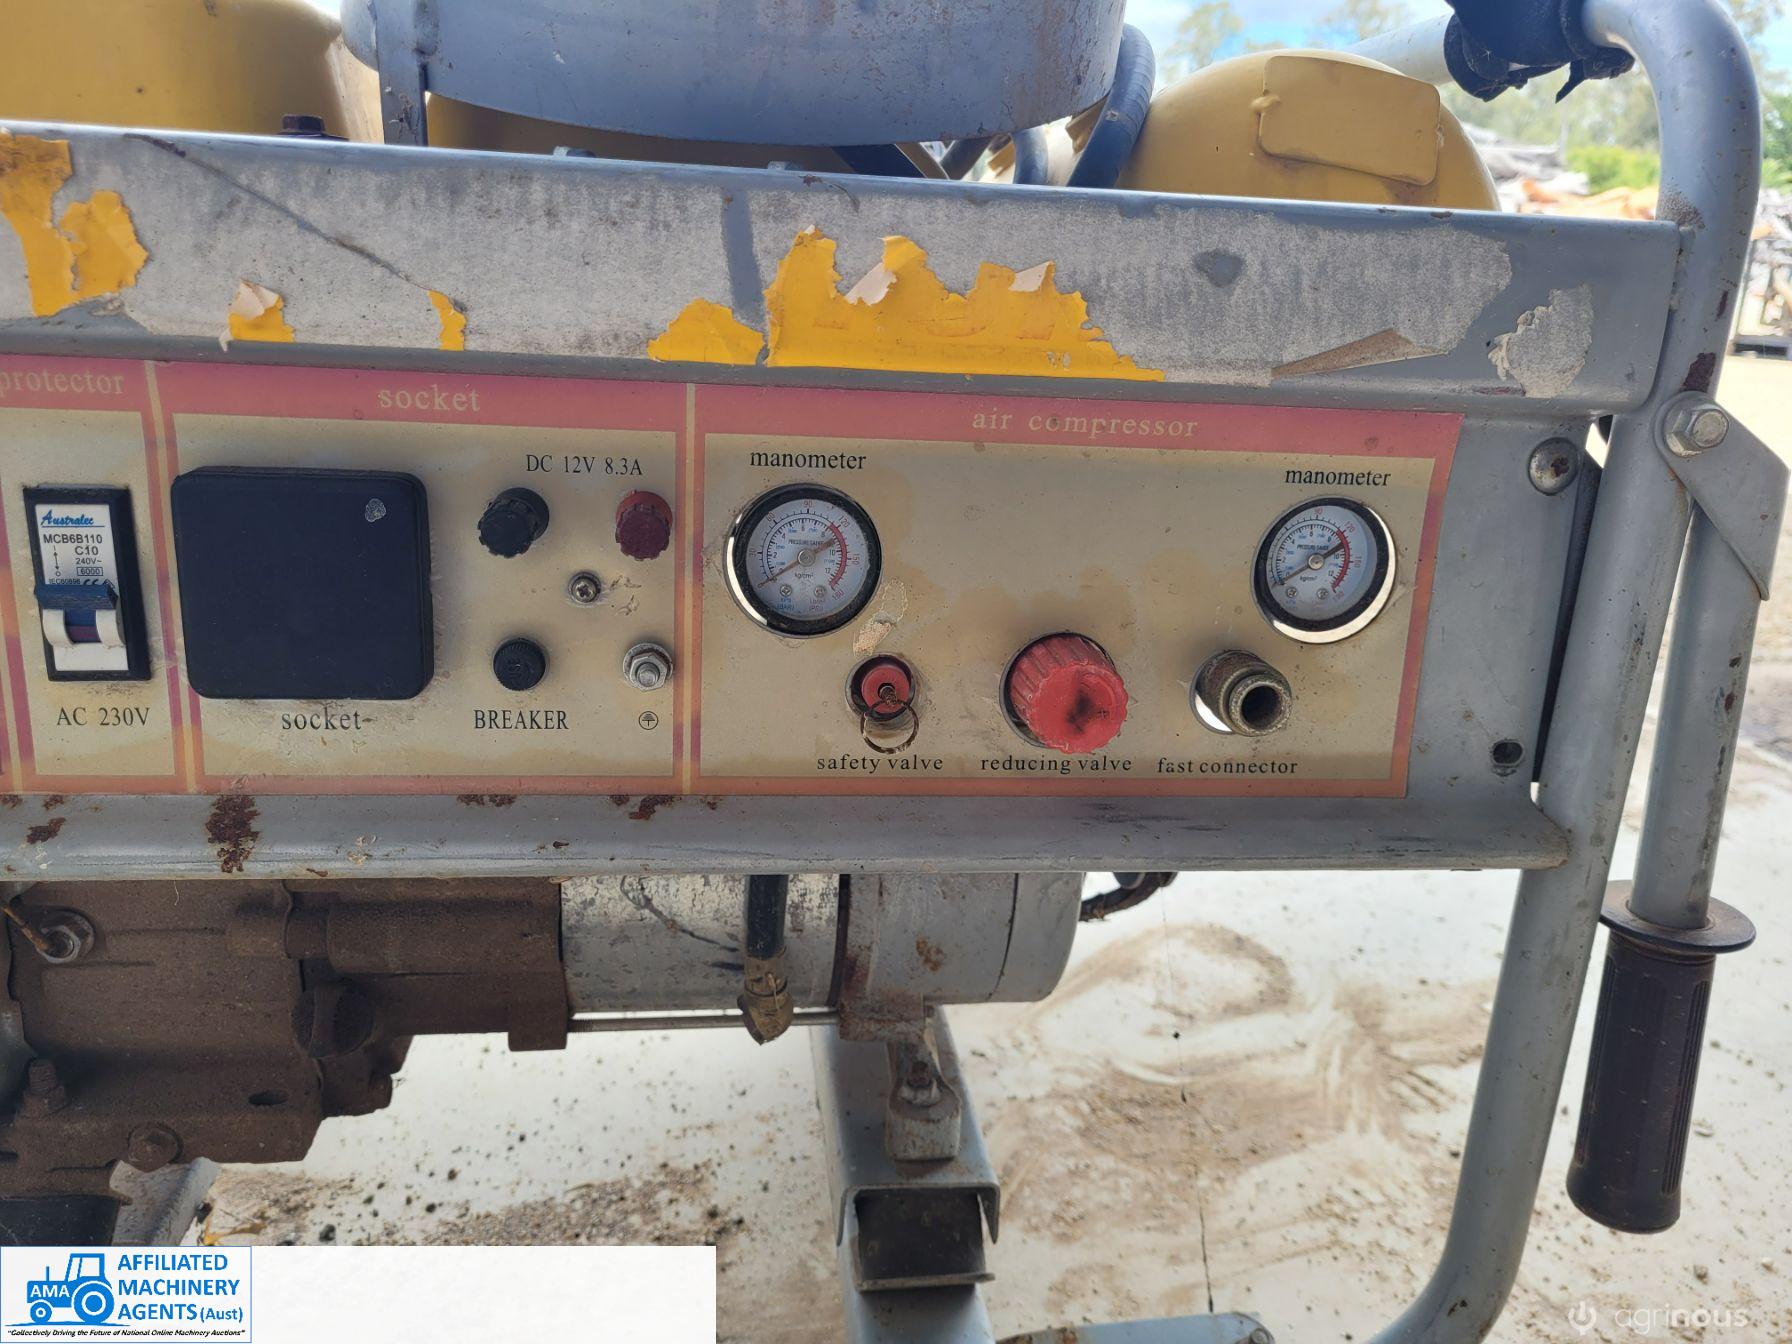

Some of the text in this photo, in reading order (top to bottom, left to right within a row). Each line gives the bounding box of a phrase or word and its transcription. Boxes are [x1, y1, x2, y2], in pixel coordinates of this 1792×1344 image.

[379, 384, 480, 412] socket
[972, 407, 1198, 440] air compressor
[526, 454, 642, 476] DC 12V 8.3A
[750, 452, 867, 470] manometer
[1285, 467, 1391, 487] manometer
[43, 534, 103, 544] MCB6B110
[75, 546, 99, 556] C10
[56, 707, 150, 726] AC 230V
[281, 708, 362, 731] socket
[473, 709, 570, 730] BREAKER
[816, 754, 944, 774] safety valve
[980, 755, 1132, 774] reducing valve
[1157, 757, 1298, 774] fast connector
